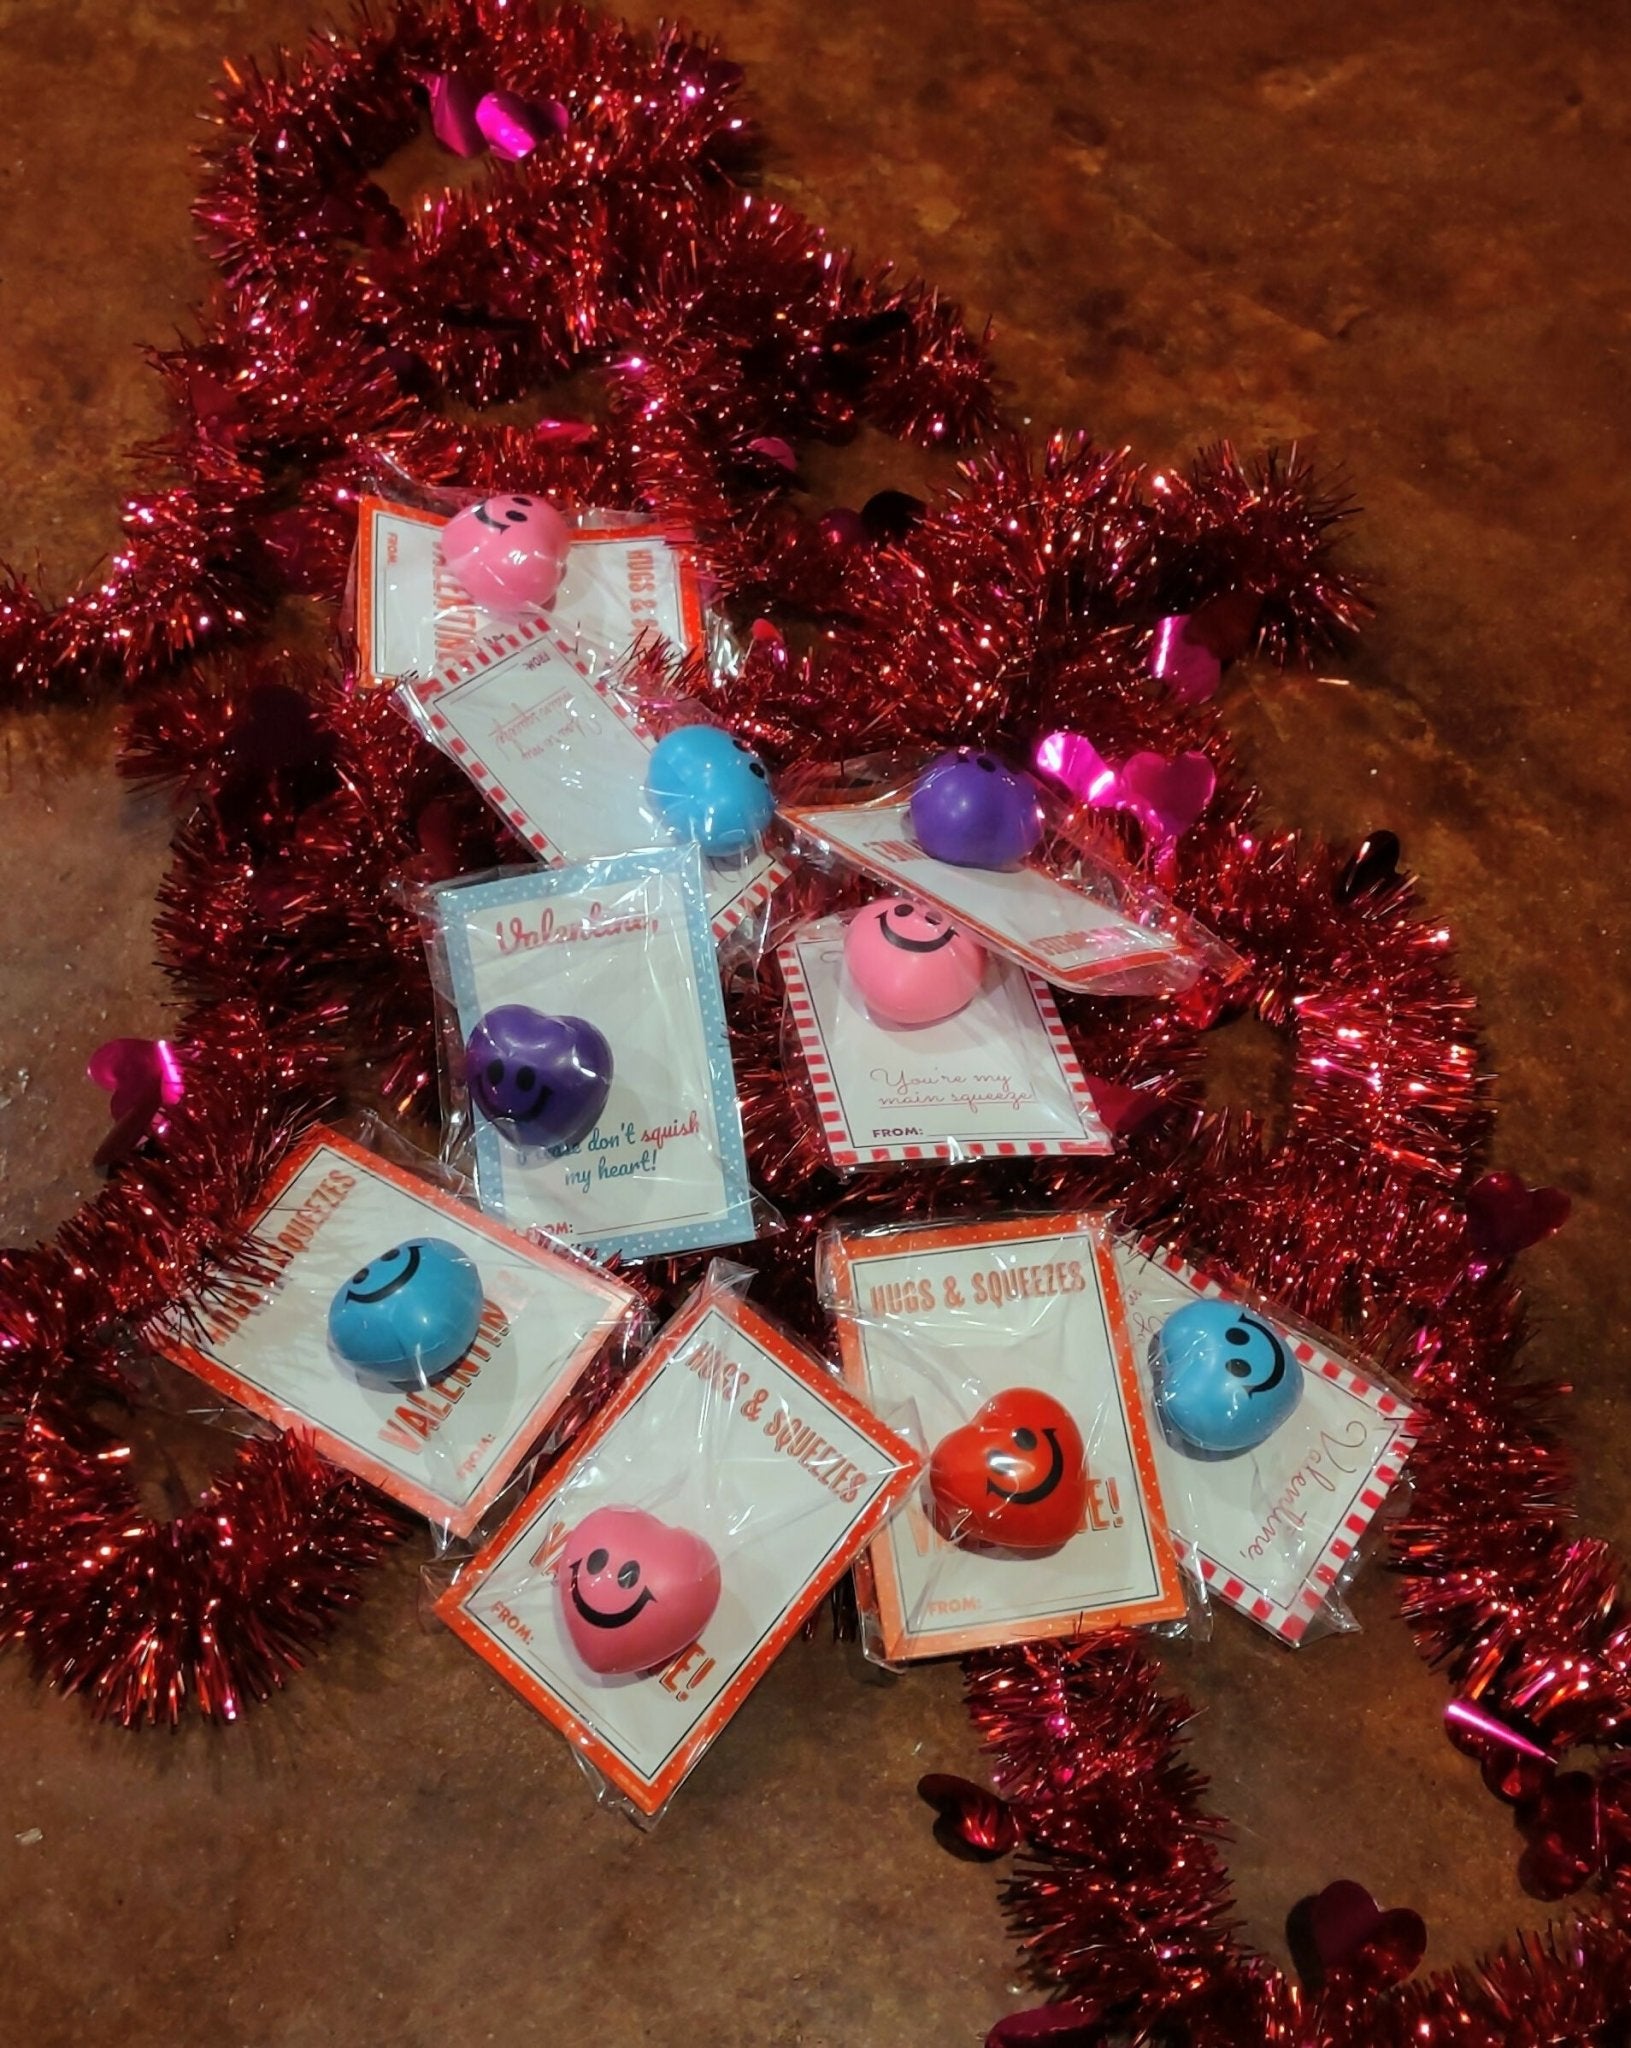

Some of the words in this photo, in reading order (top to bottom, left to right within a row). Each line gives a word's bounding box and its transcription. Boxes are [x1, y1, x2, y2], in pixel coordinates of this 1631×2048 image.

[627, 549, 655, 593] HUGS
[629, 599, 658, 614] &
[870, 1067, 967, 1095] You're
[974, 1074, 1012, 1092] my
[879, 1094, 944, 1106] main
[951, 1091, 1034, 1113] squeeze
[588, 1122, 634, 1151] don't
[641, 1110, 699, 1150] squish
[873, 1127, 923, 1139] FROM:
[565, 1165, 591, 1193] my
[599, 1150, 657, 1180] heart!
[870, 1278, 935, 1317] HUGS
[943, 1276, 965, 1306] &
[972, 1261, 1086, 1310] SQUEEZES
[685, 1341, 750, 1401] HUGS
[740, 1388, 769, 1421] &
[763, 1409, 867, 1503] SQUEEZES
[1240, 1420, 1368, 1560] Valentine,
[490, 1600, 535, 1646] FROM:
[928, 1597, 982, 1616] FROM:
